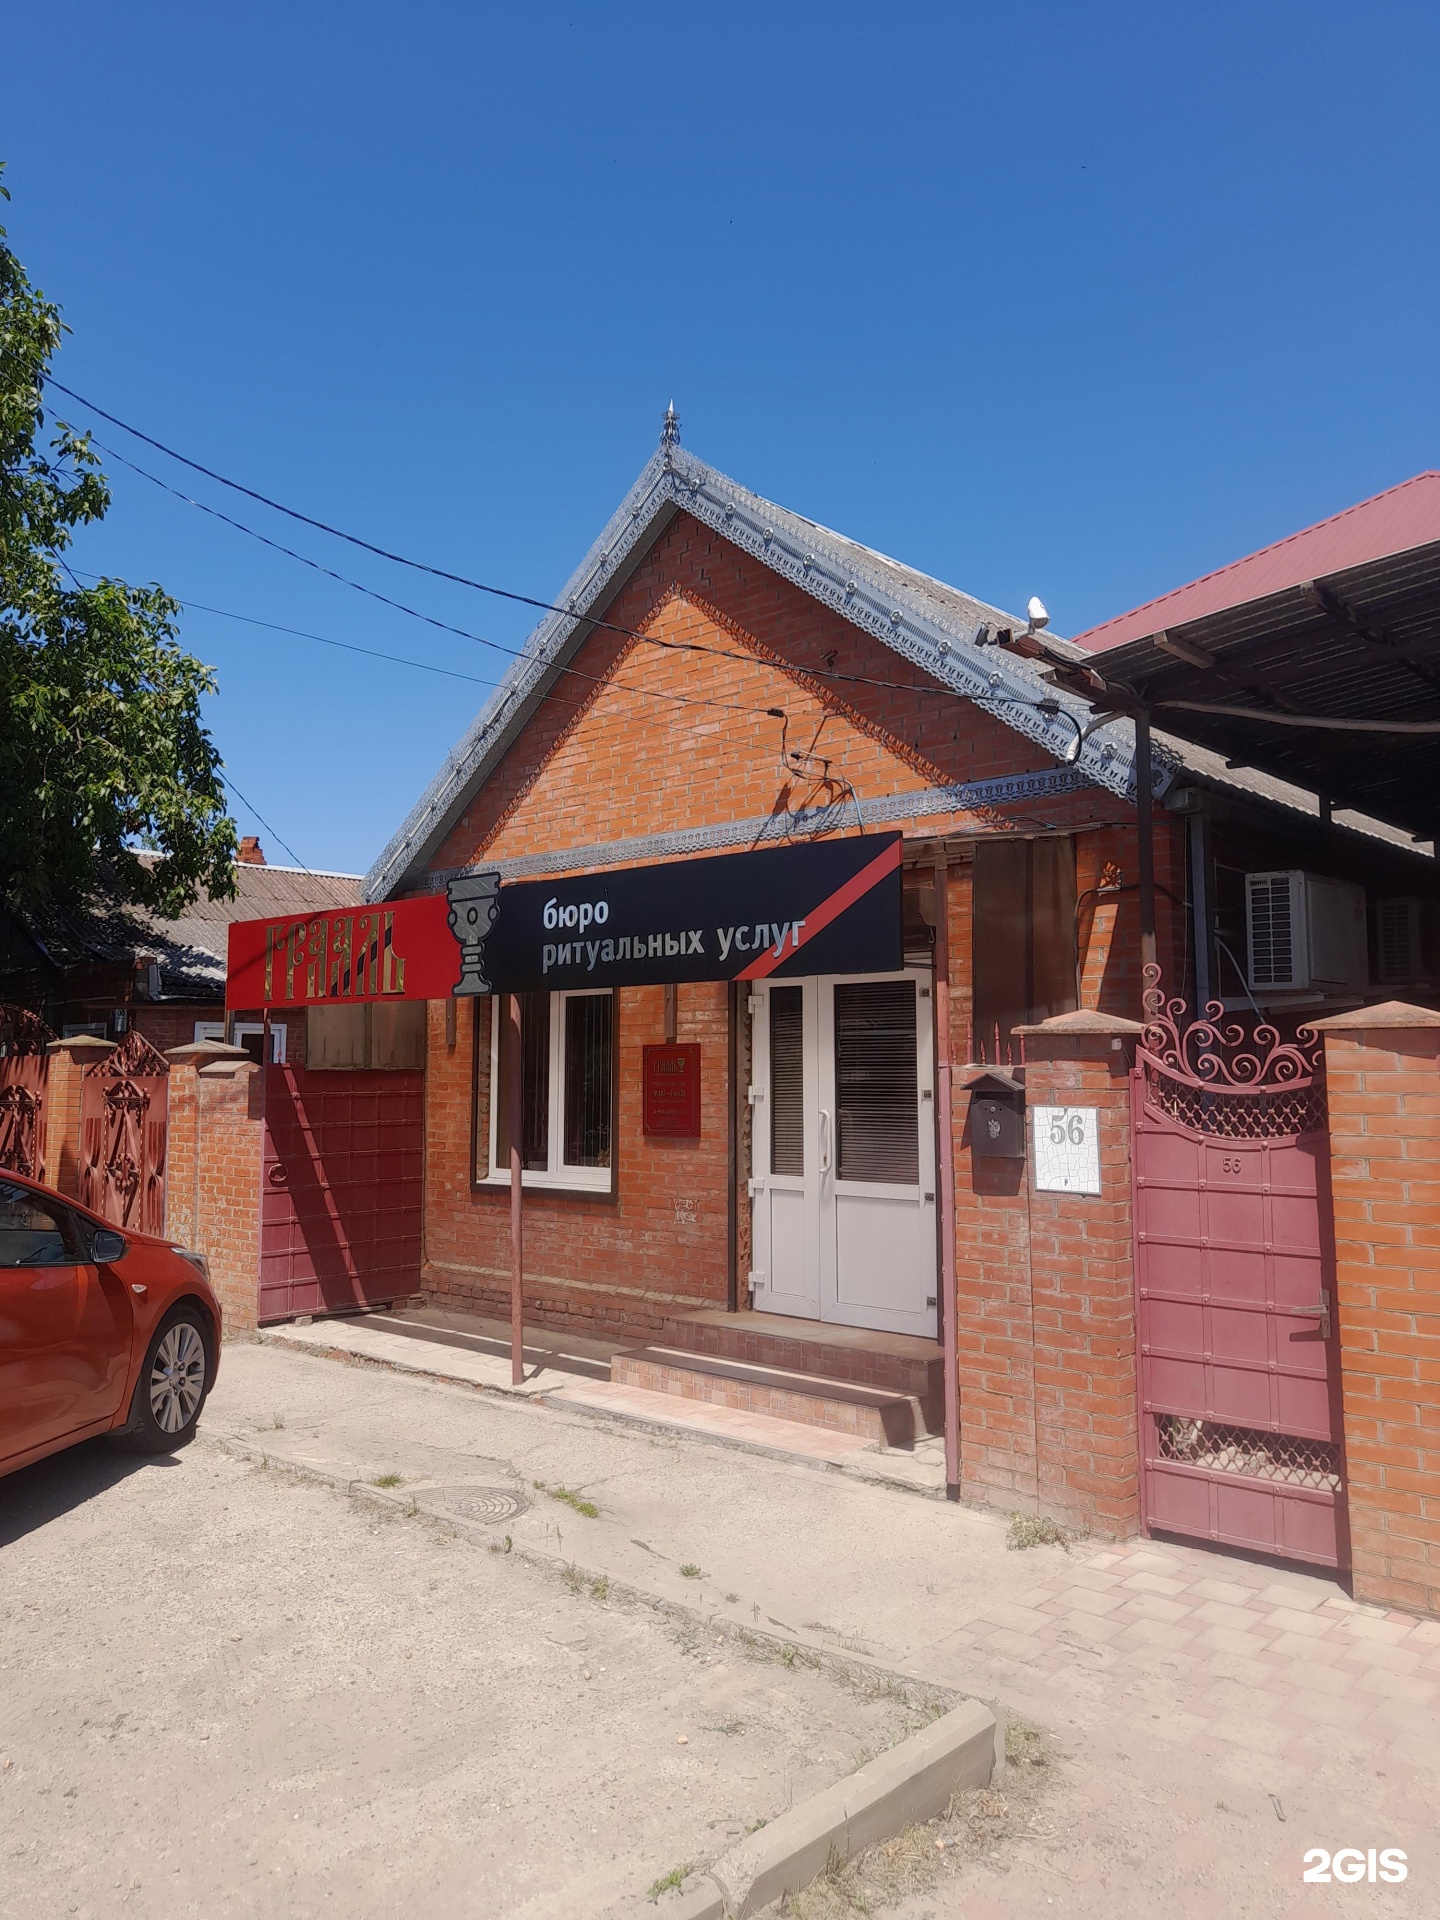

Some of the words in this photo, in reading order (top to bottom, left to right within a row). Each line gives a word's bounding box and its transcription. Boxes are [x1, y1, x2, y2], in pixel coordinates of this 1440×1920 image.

[543, 897, 609, 934] бюро
[542, 929, 705, 974] ритуальных
[716, 920, 806, 962] услуг
[1050, 1110, 1084, 1145] 56
[1222, 1156, 1242, 1173] 56
